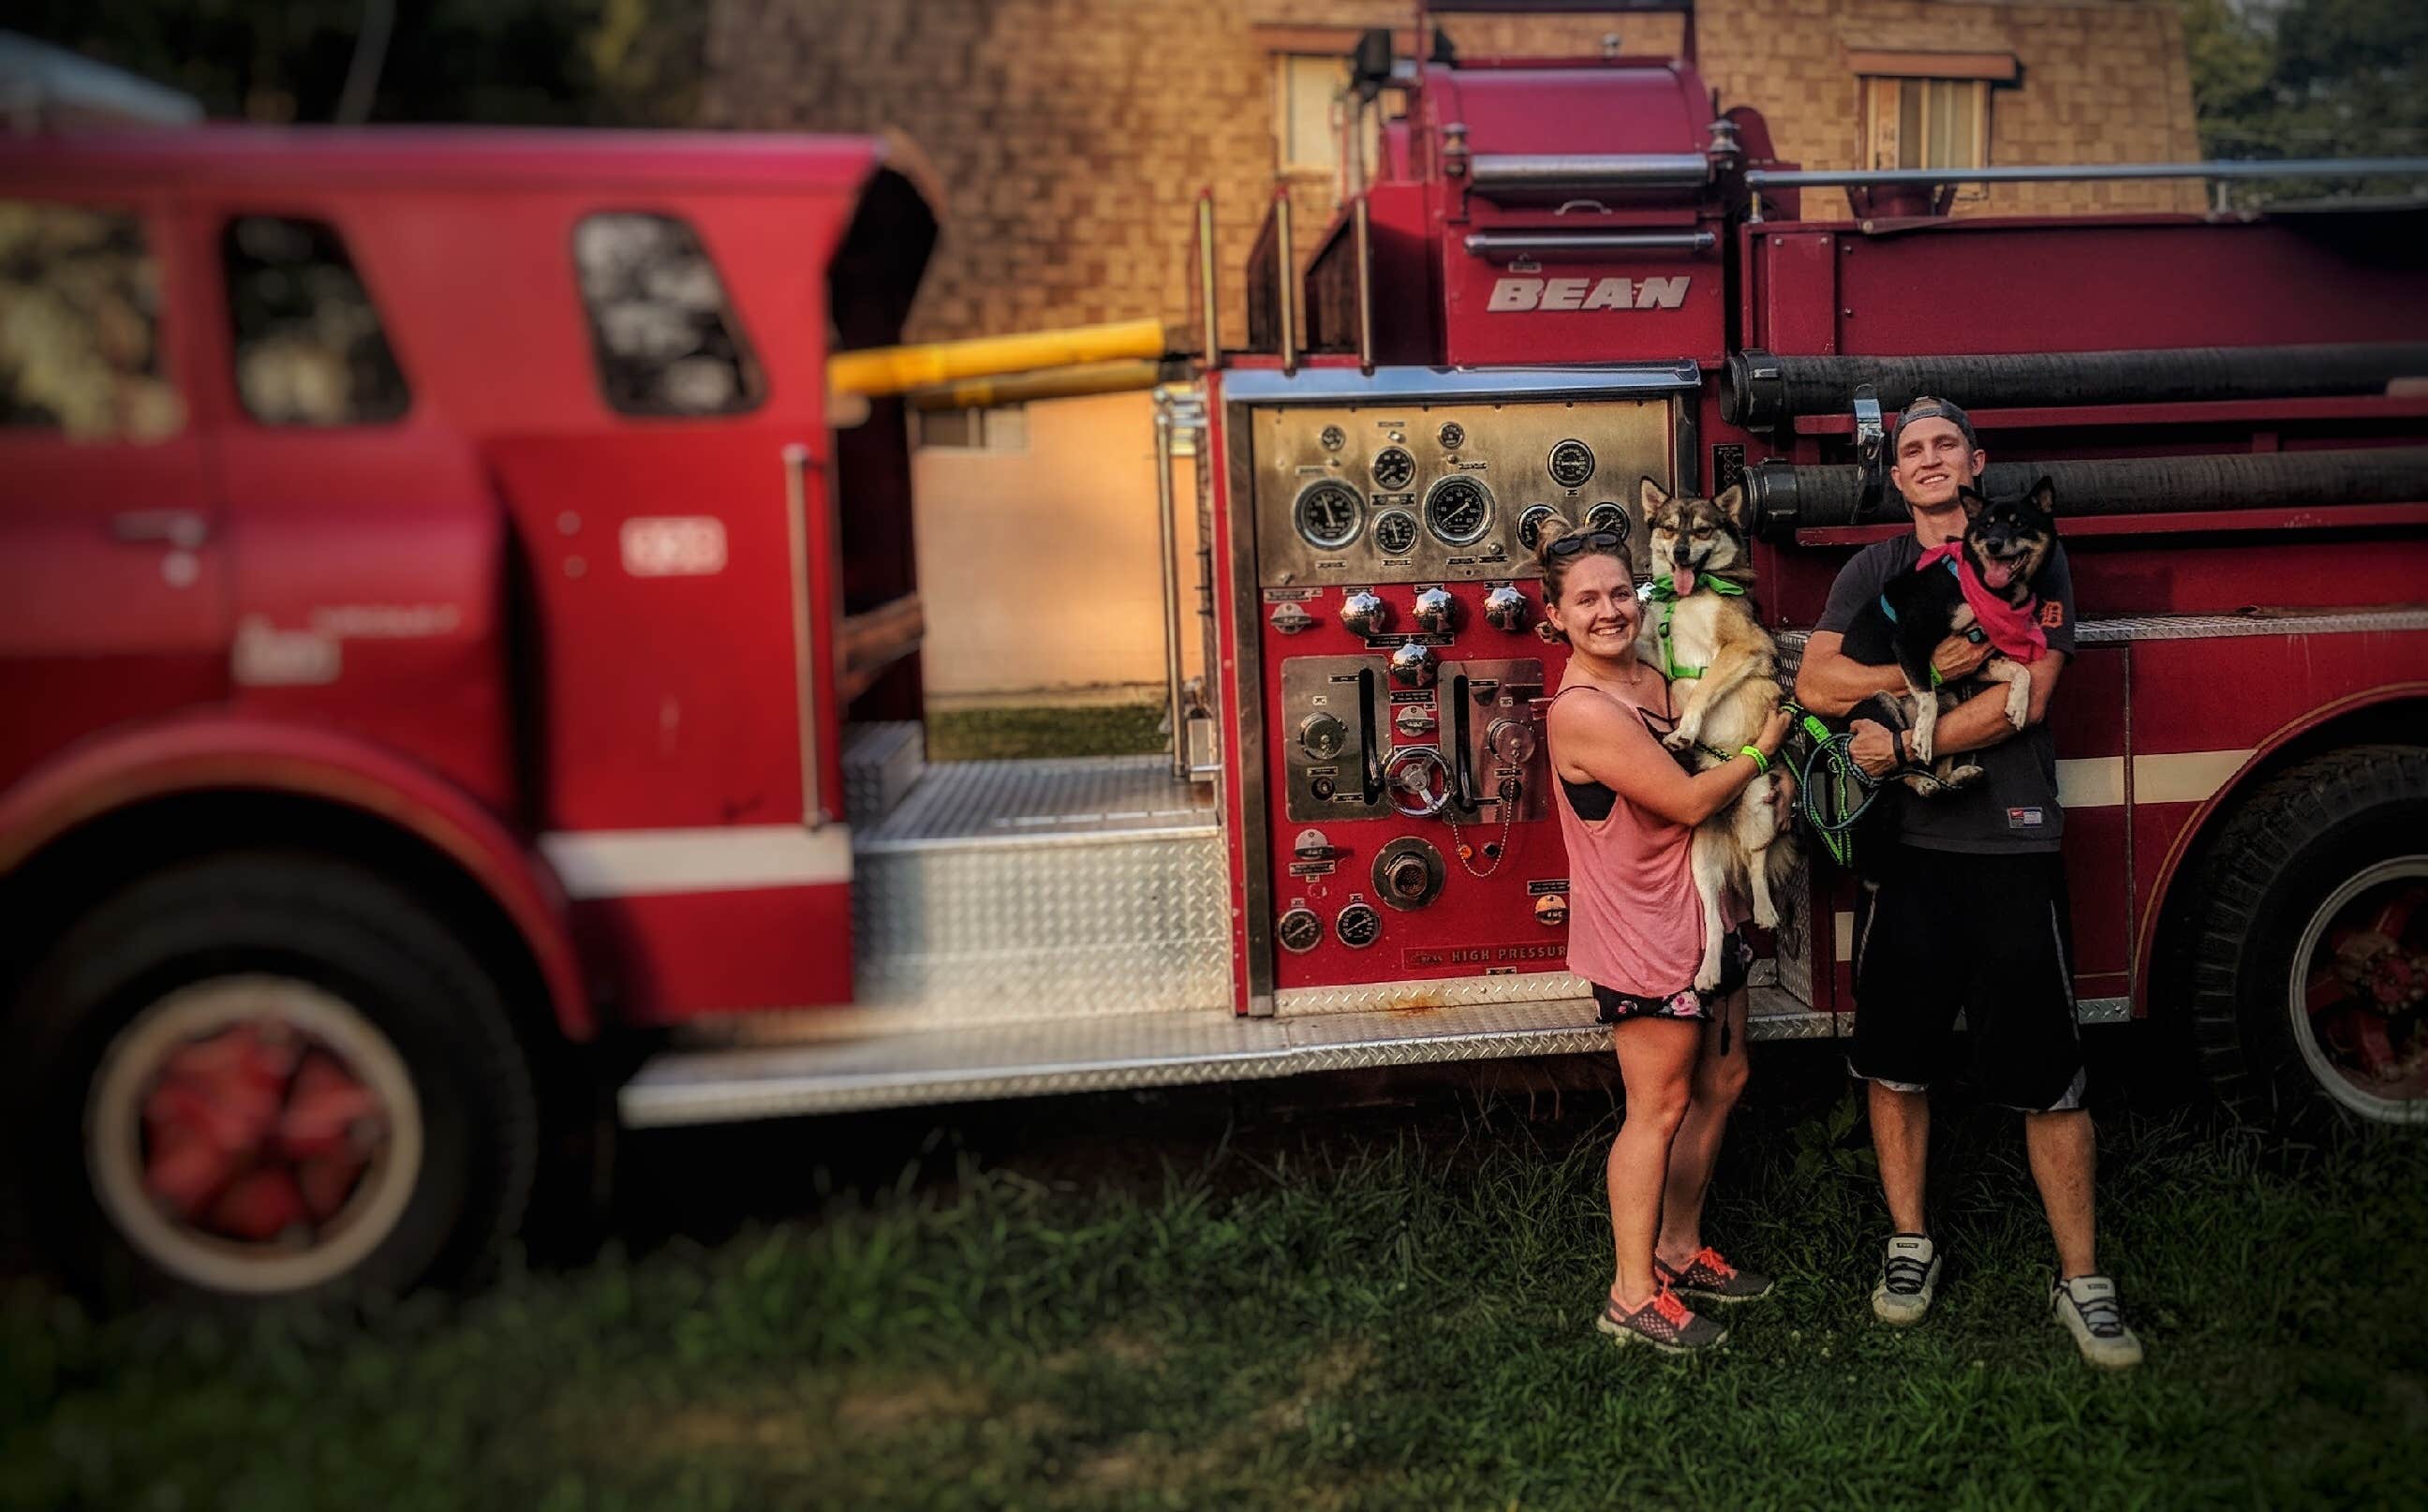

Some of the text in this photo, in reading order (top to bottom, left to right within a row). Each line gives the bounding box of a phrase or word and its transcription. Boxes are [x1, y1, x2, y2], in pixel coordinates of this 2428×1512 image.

[1487, 276, 1690, 311] BEAN
[1452, 949, 1489, 962] HIGH
[1499, 945, 1566, 960] PRESSUR
